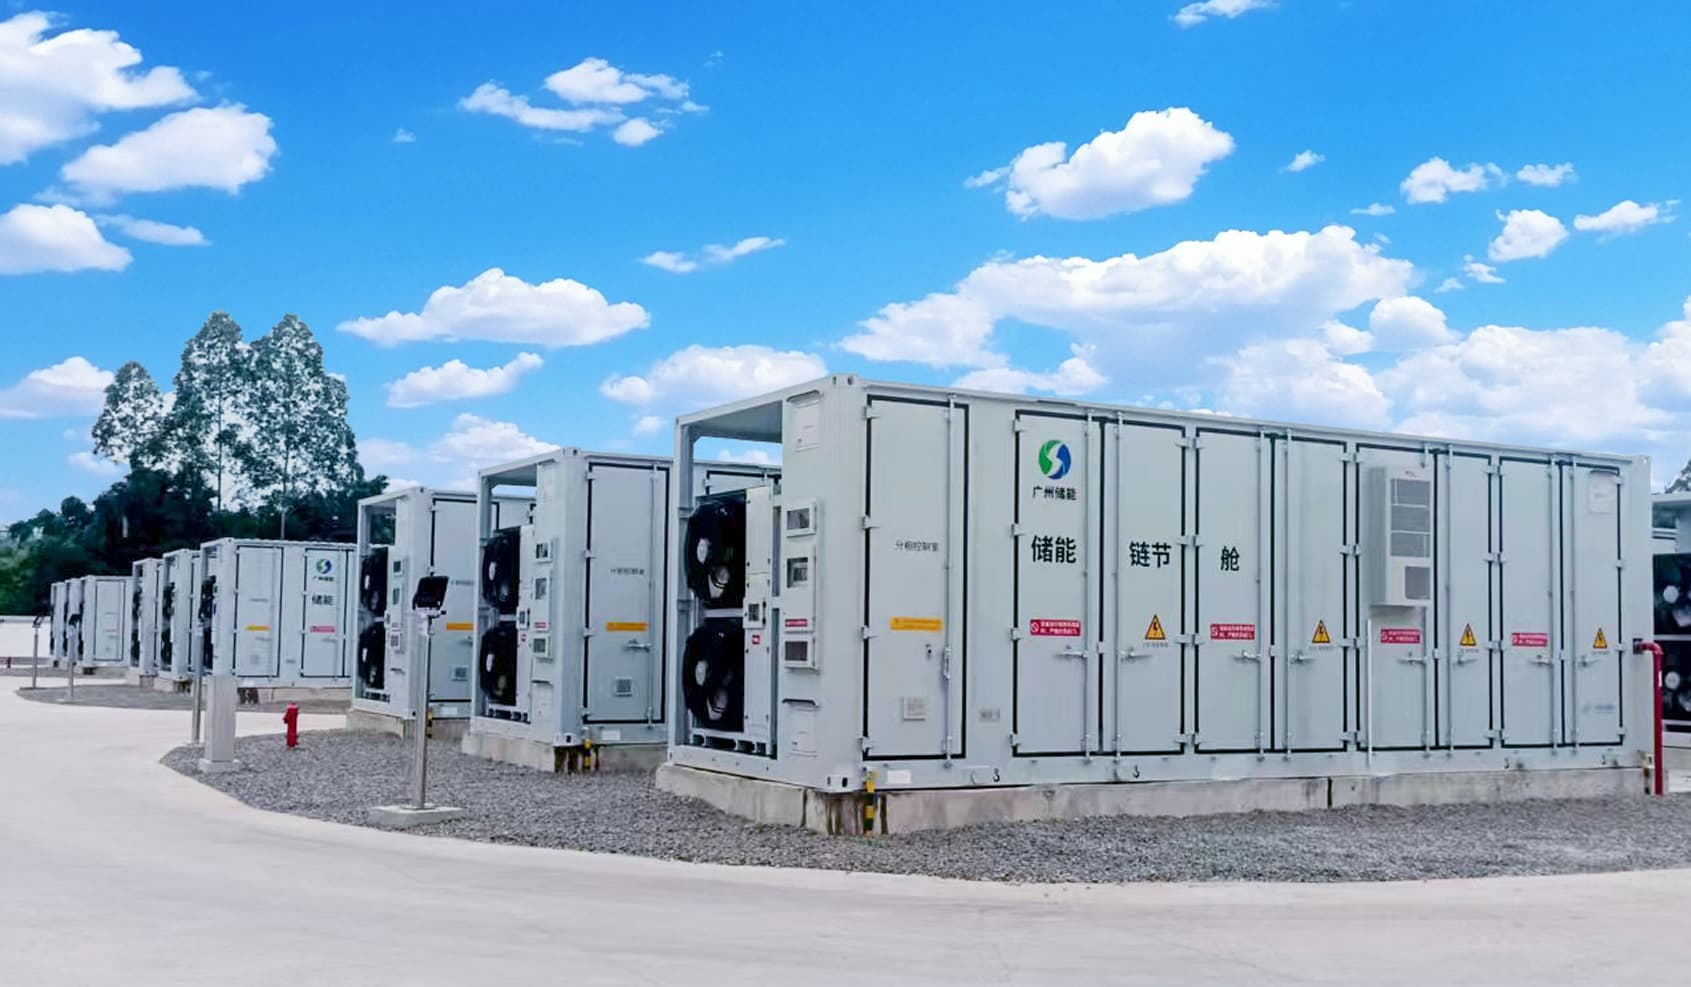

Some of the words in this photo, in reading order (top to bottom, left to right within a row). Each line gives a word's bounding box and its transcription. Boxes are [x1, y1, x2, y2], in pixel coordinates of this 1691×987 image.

[1032, 485, 1076, 501] 广州储能
[1031, 534, 1077, 564] 储能
[1129, 541, 1172, 568] 链节
[1220, 545, 1240, 571] 舱
